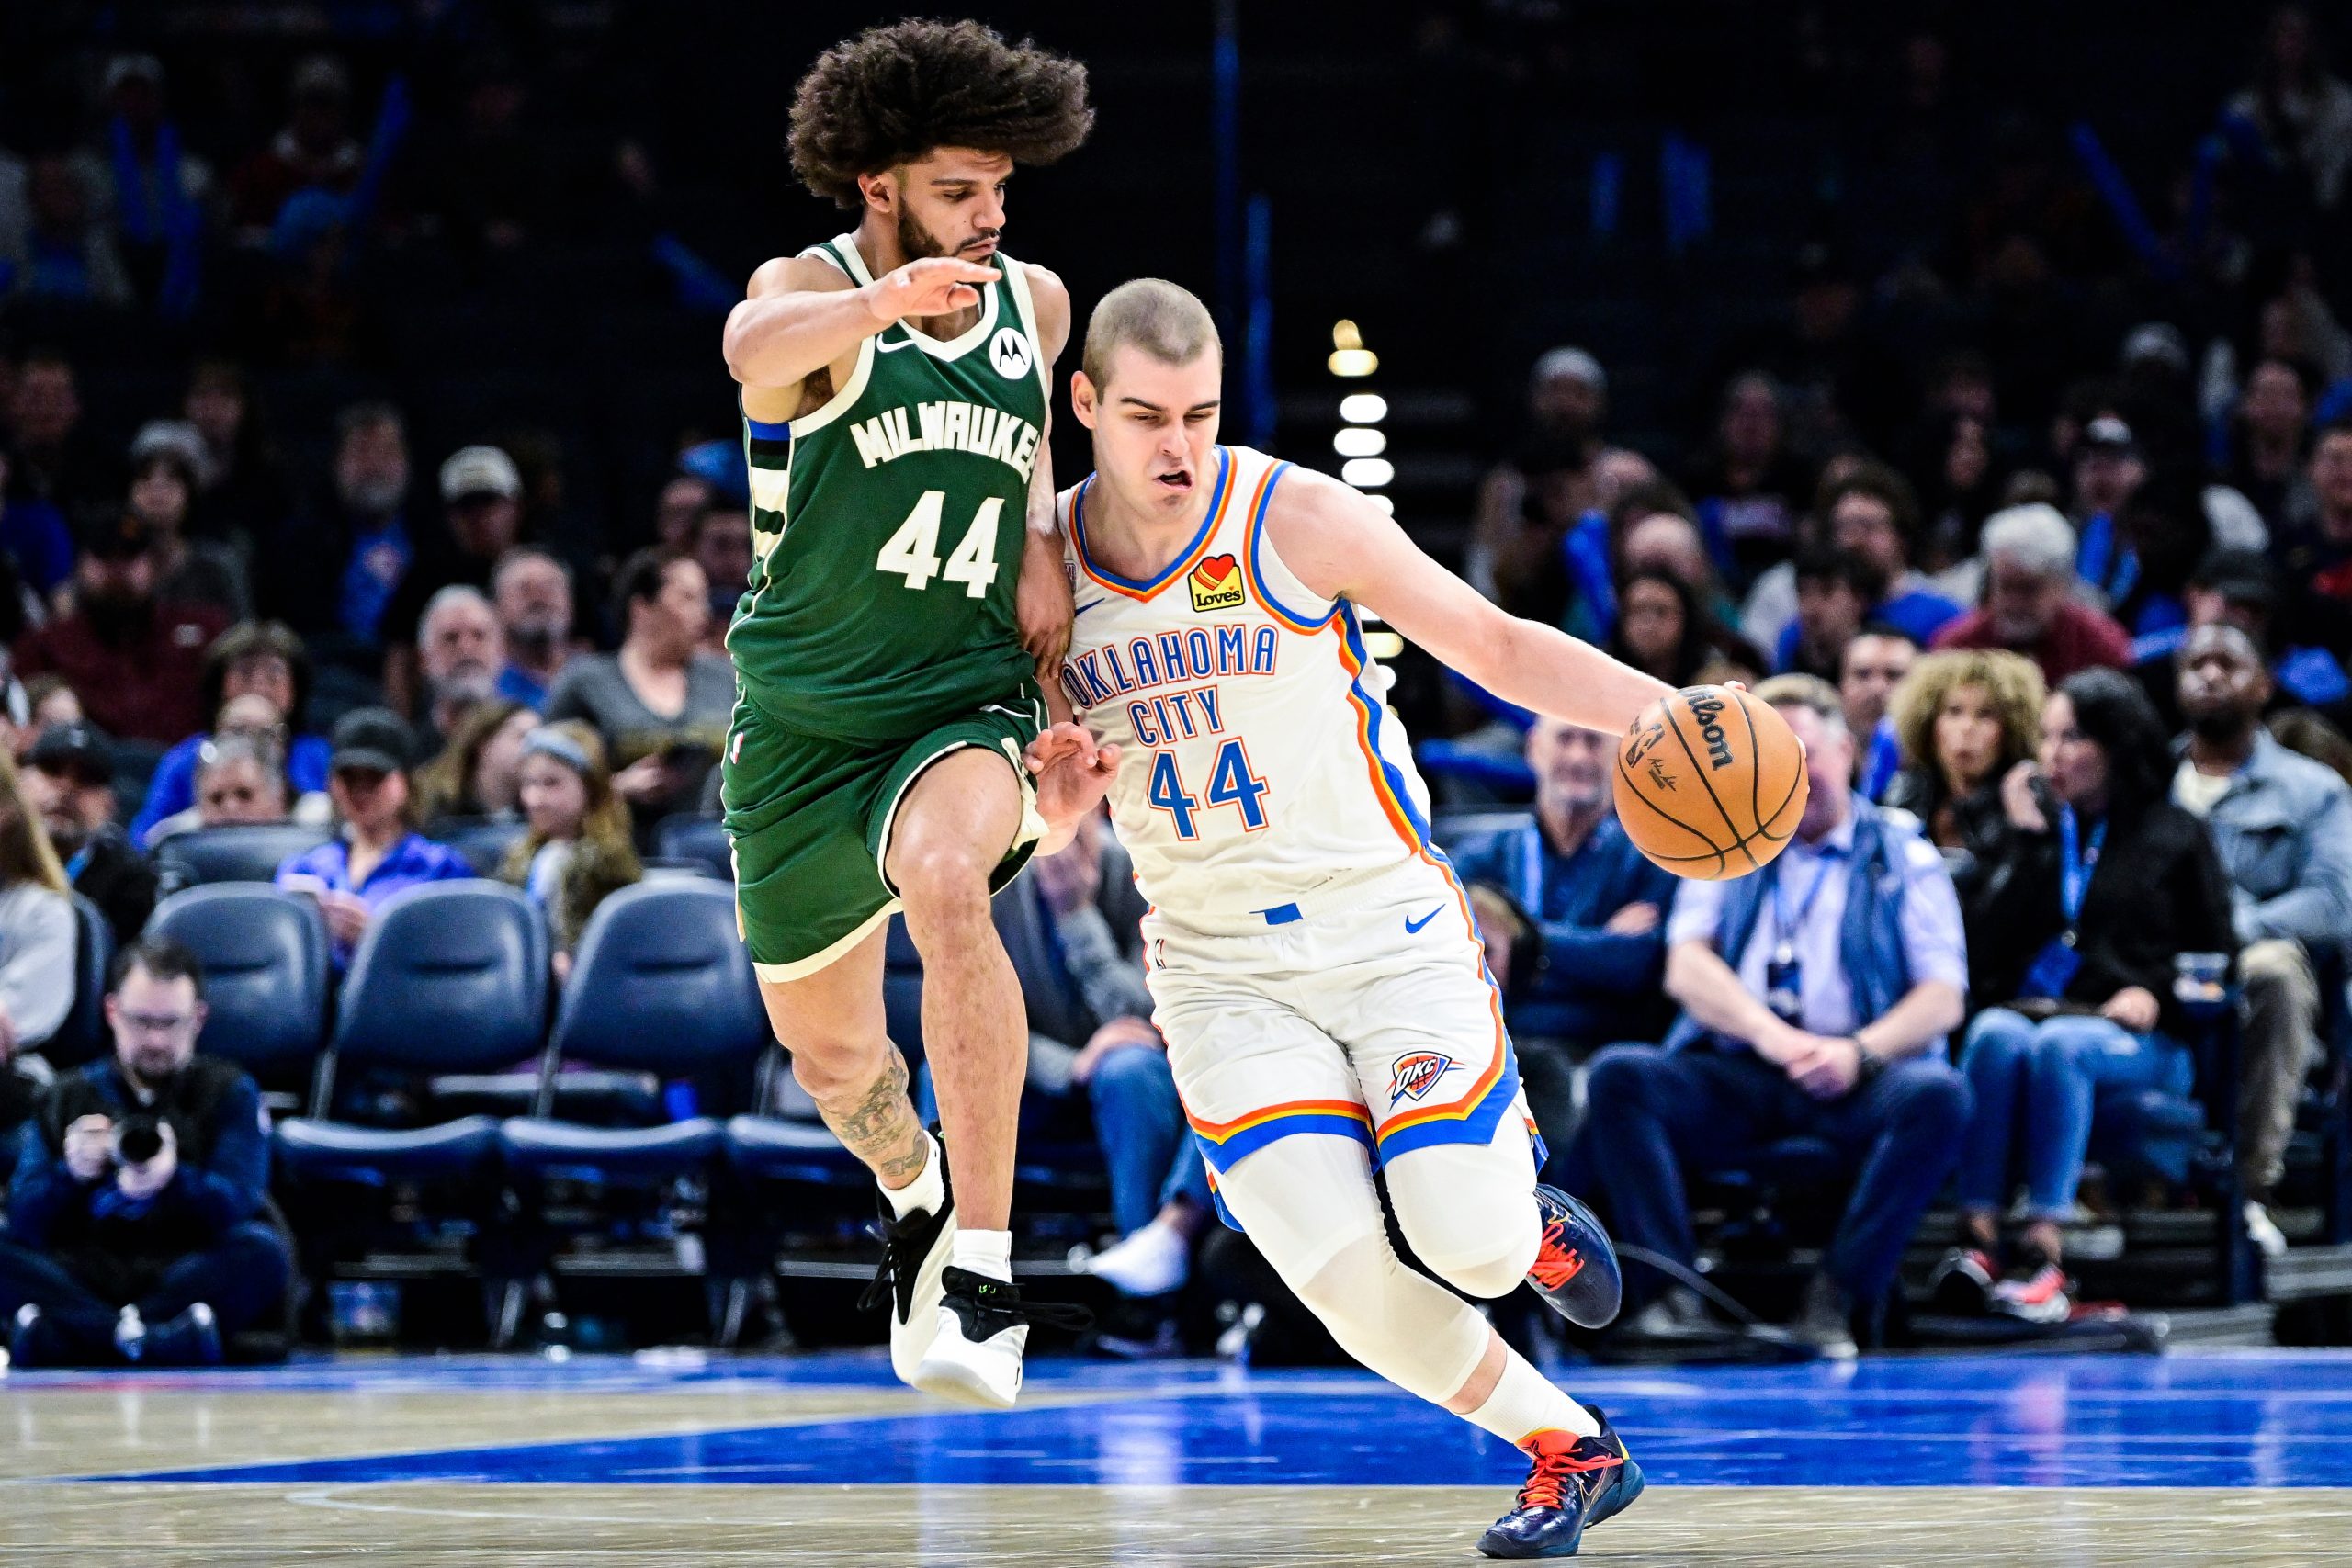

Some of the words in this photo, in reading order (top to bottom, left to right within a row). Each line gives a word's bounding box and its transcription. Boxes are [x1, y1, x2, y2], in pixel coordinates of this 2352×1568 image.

[876, 490, 1005, 599] 44
[1059, 624, 1280, 710] OKLAHOMA
[1126, 684, 1225, 748] CITY
[1147, 736, 1271, 841] 44
[1391, 1057, 1439, 1100] OKC
